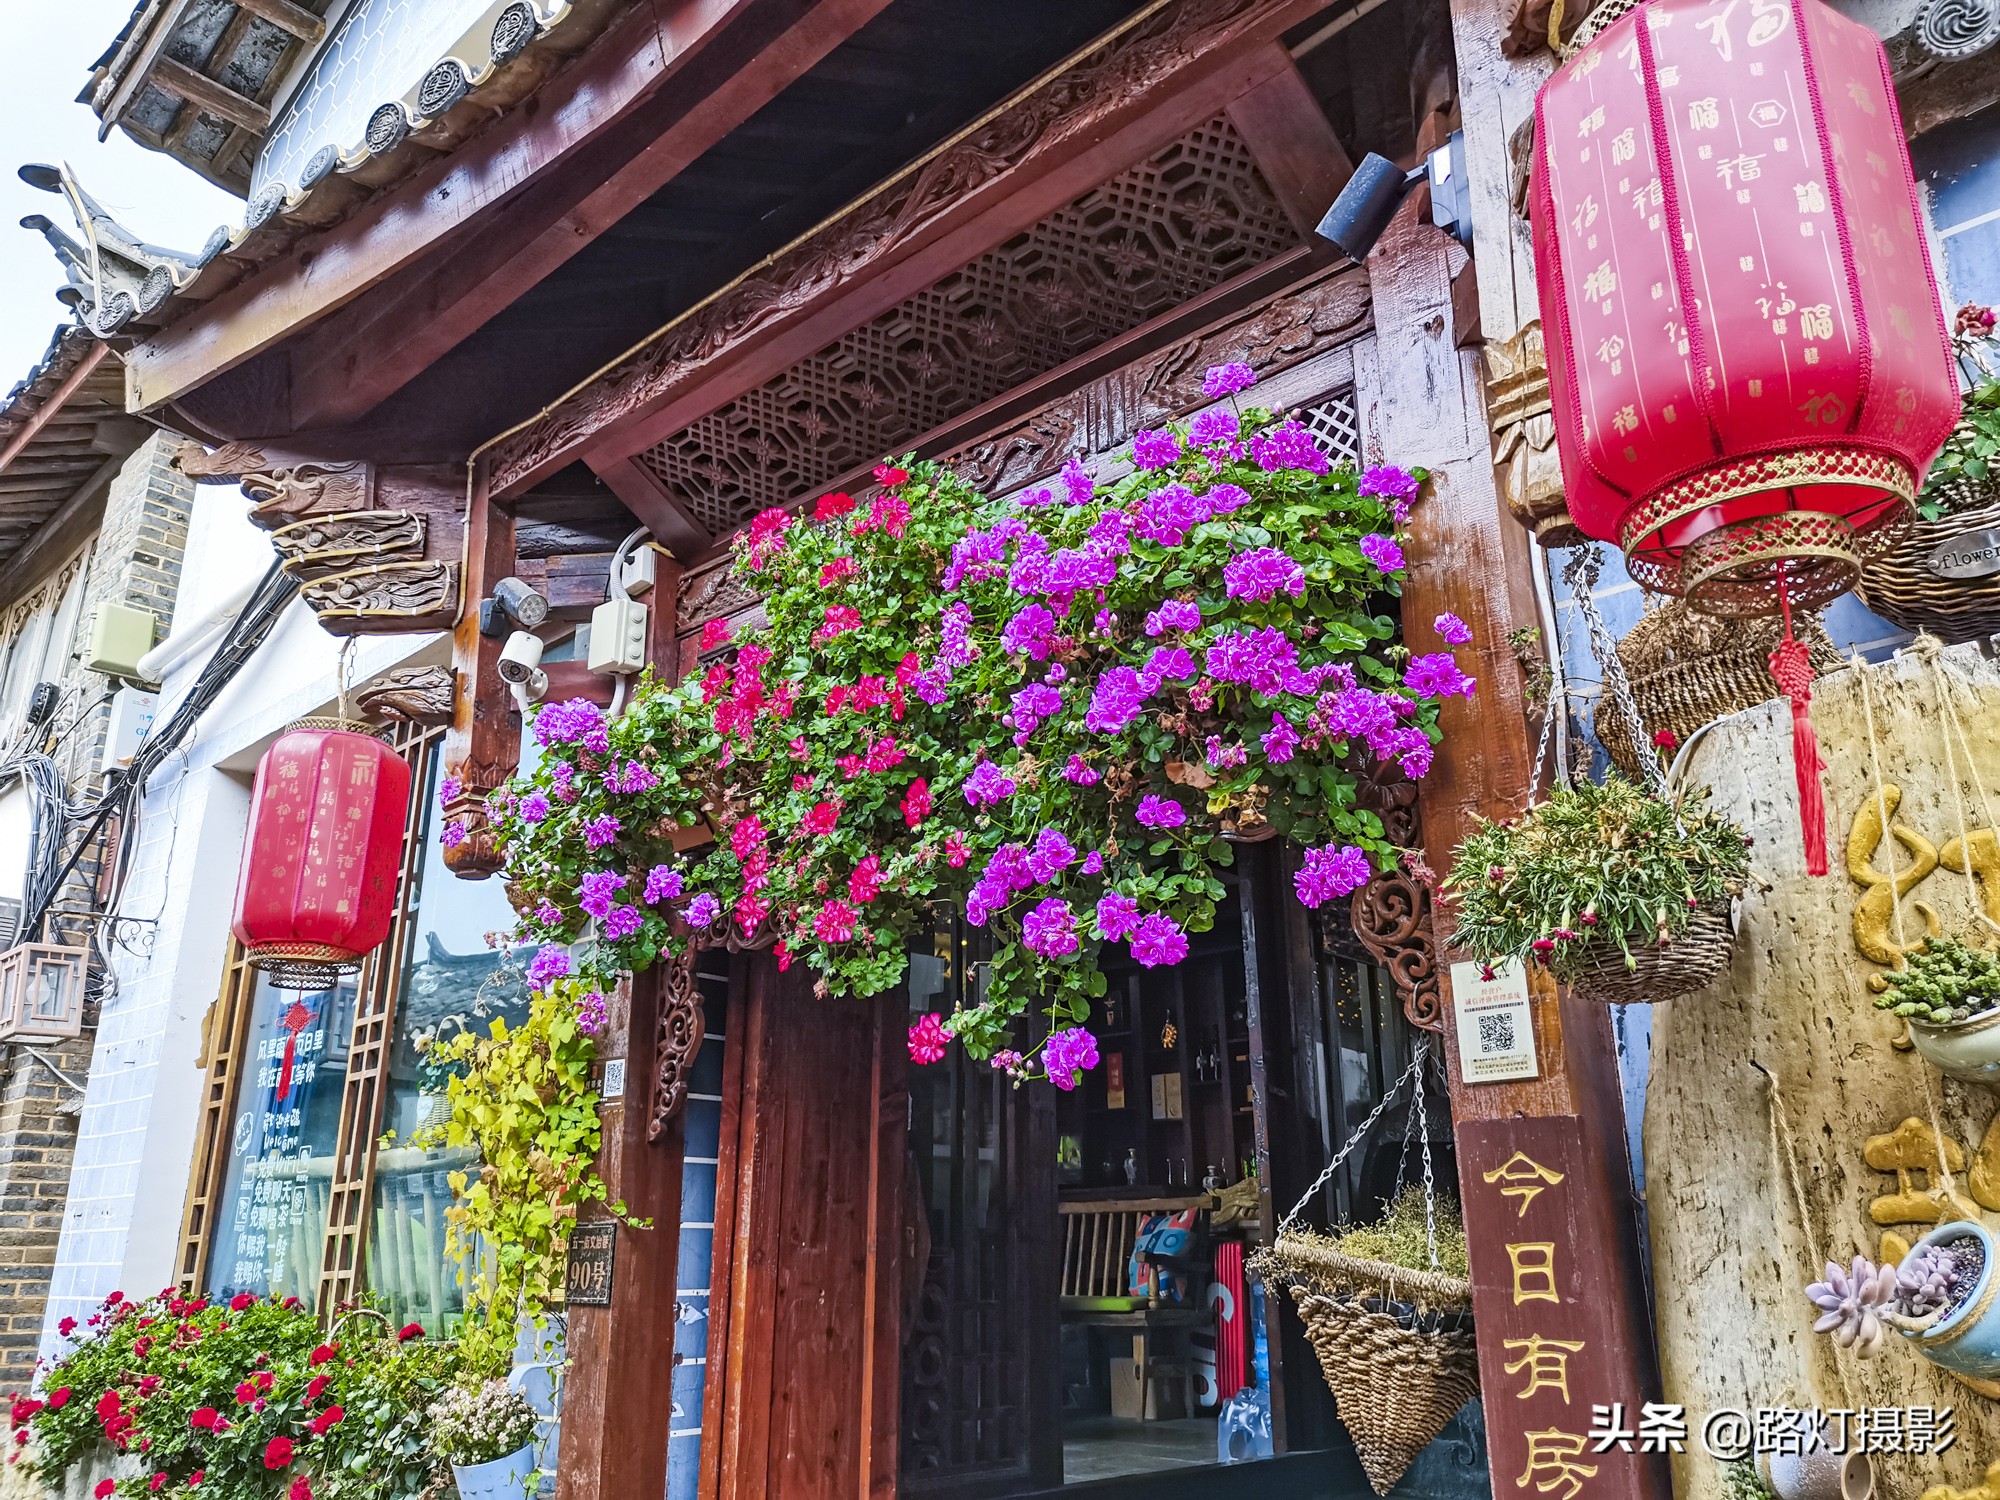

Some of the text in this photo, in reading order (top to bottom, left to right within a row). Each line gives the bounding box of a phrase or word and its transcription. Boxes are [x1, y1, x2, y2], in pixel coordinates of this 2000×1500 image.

[1716, 153, 1767, 190] 福
[1583, 259, 1617, 302] 福
[1800, 303, 1832, 341] 福
[257, 1029, 324, 1062] 风里雨节日里
[253, 1179, 293, 1204] 免费聊天
[249, 1203, 290, 1230] 免费喝茶
[570, 1260, 607, 1290] 90号
[1483, 1151, 1598, 1500] 今日有房
